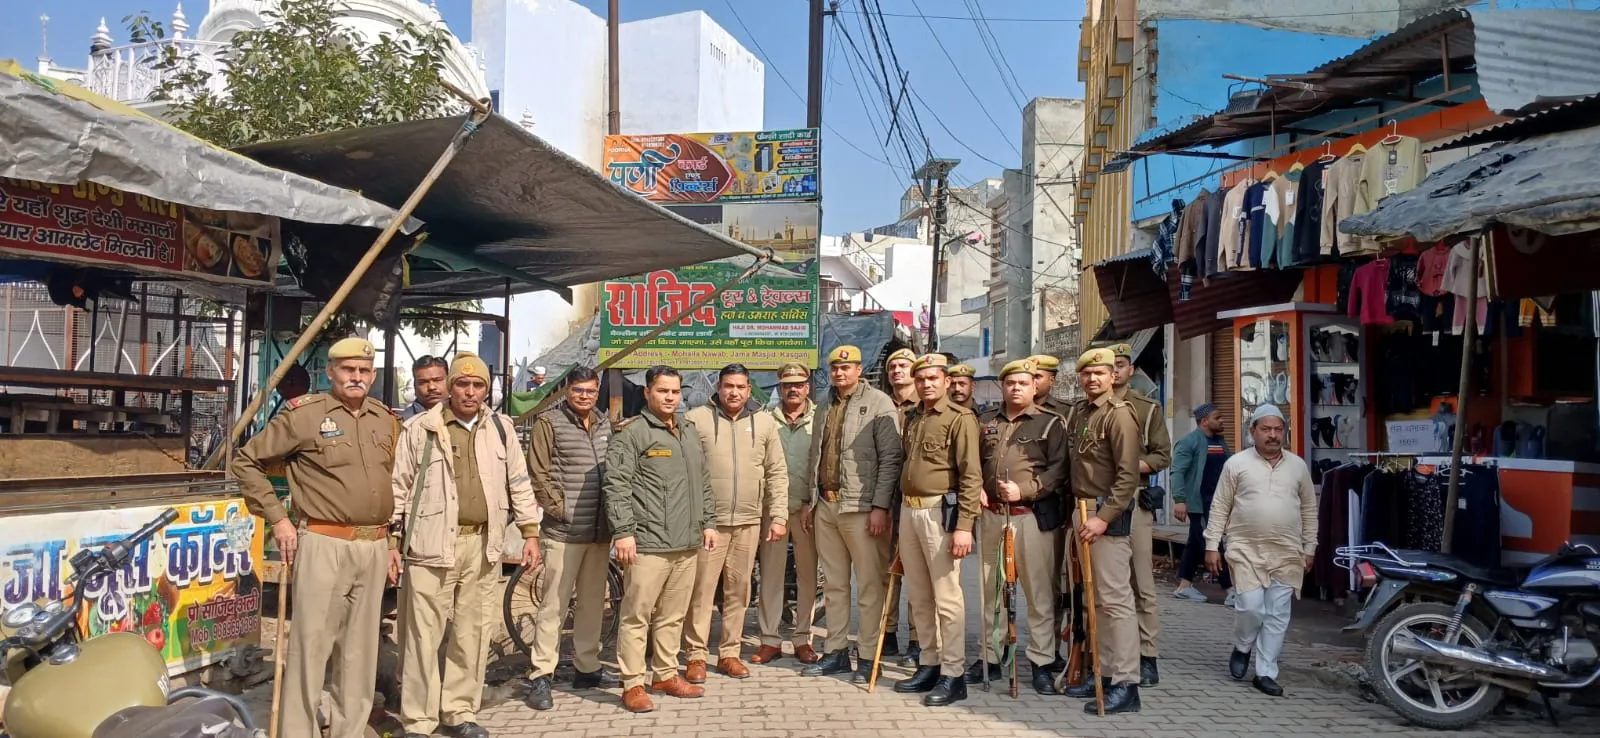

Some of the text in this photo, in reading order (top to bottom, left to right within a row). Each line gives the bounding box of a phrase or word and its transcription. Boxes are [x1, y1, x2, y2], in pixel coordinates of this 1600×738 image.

[55, 204, 89, 229] शुद्ध
[91, 207, 124, 232] देशी
[126, 216, 176, 241] मसालों
[32, 226, 104, 251] आमलेट
[105, 234, 155, 260] मिलती
[605, 270, 716, 327] साजिद
[721, 289, 744, 308] टूर
[747, 288, 758, 303] &
[747, 310, 778, 320] उमराह
[780, 308, 808, 320] सर्विस
[201, 594, 235, 620] साजिद
[236, 587, 260, 614] अली
